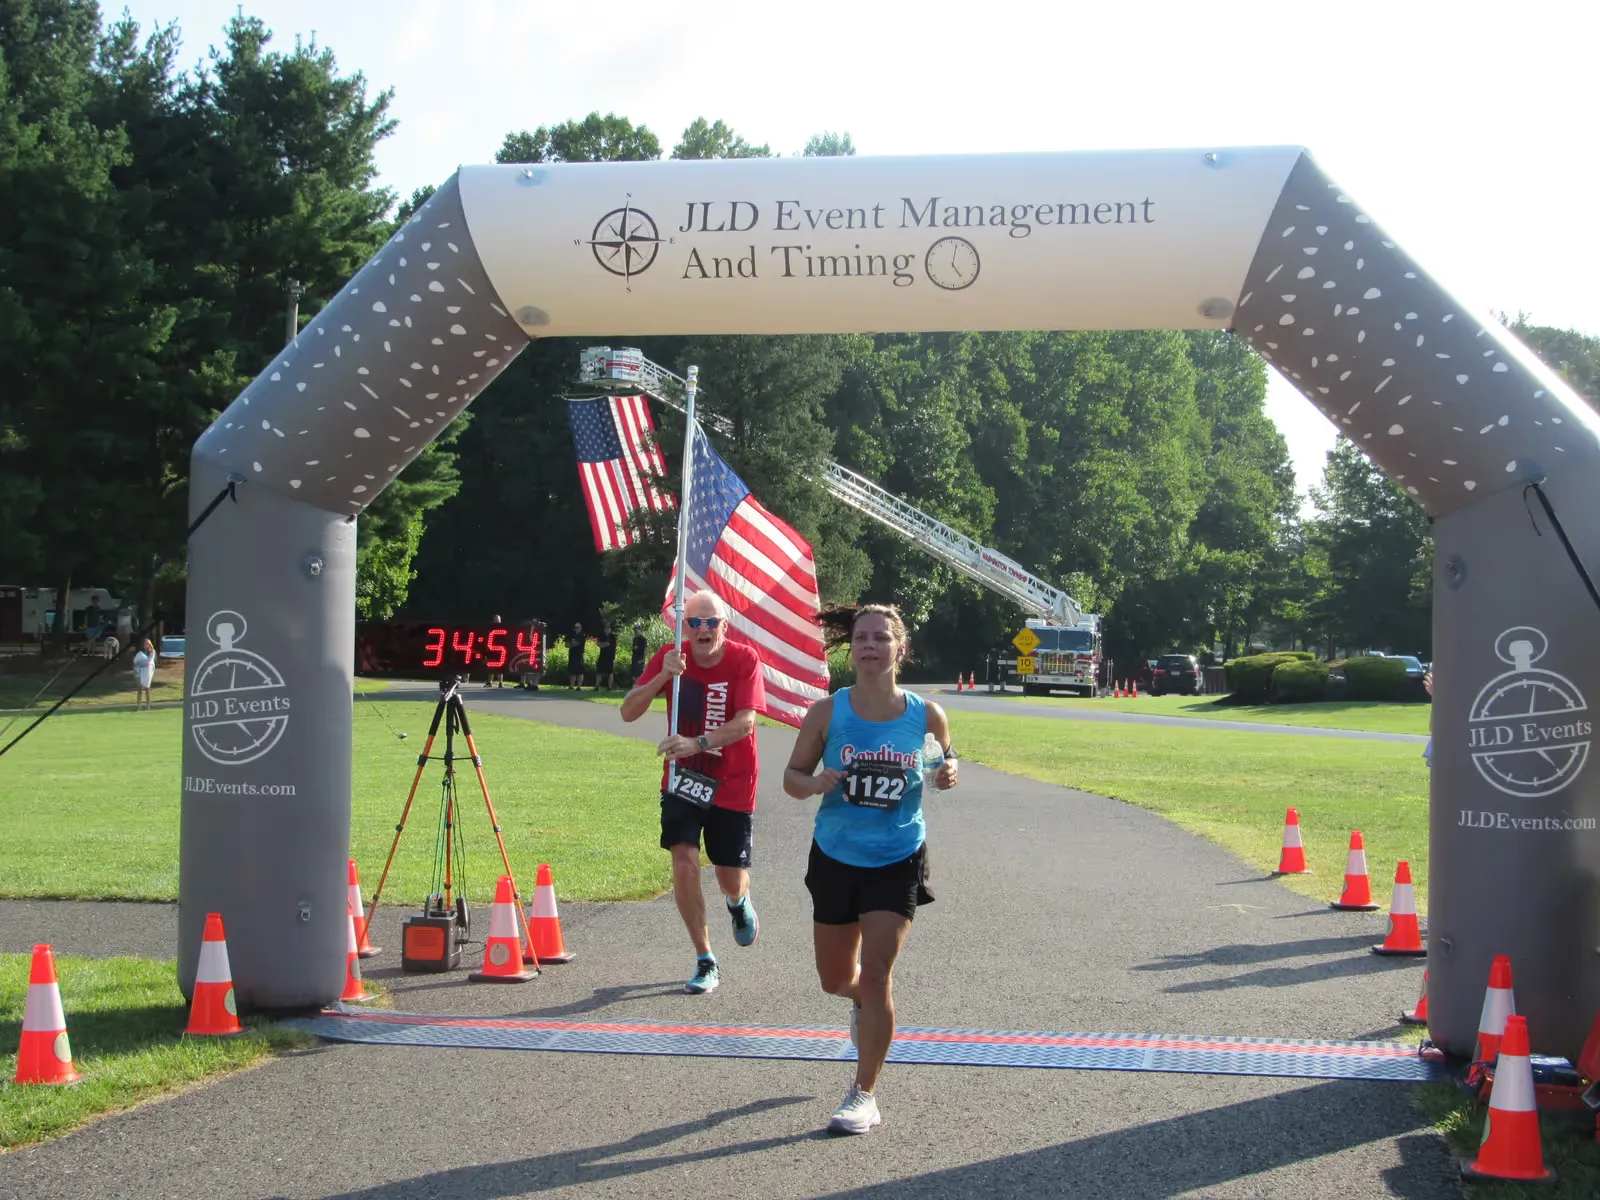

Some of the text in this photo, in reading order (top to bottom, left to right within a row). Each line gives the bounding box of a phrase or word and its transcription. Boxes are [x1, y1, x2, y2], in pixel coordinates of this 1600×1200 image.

[679, 196, 1156, 238] JLD Event Management
[681, 244, 915, 287] And Timing
[423, 628, 539, 668] 34:54
[1020, 658, 1031, 667] 10
[190, 696, 290, 720] JLD Events
[704, 681, 729, 757] AERICA
[1468, 720, 1592, 748] JLD Events
[184, 776, 297, 796] JLDEvents.com
[846, 774, 905, 800] 1122
[1457, 809, 1597, 831] JLDEvents.com
